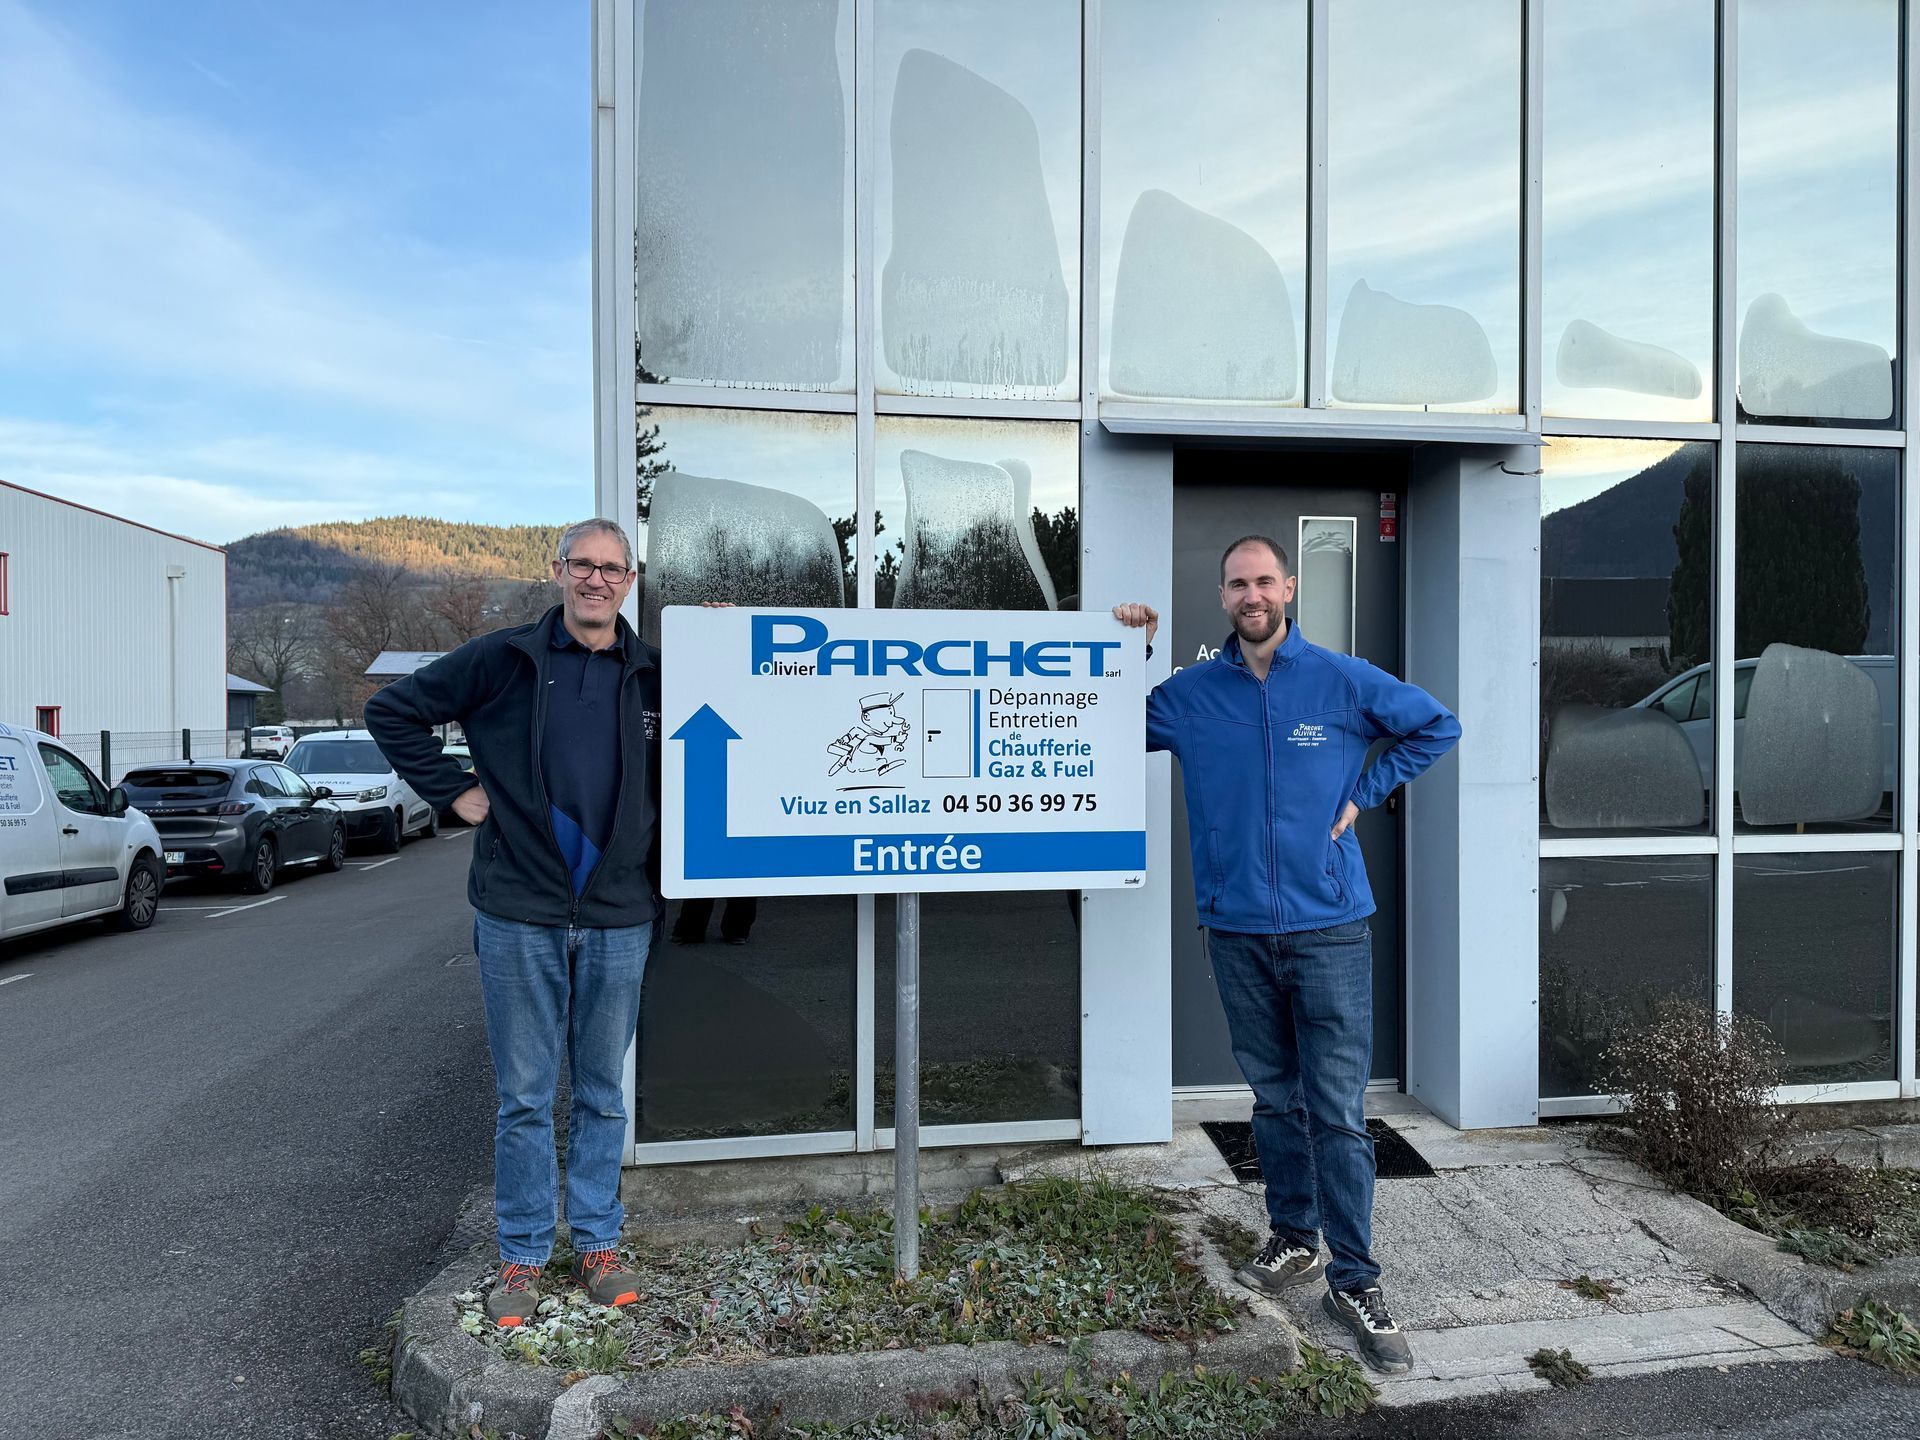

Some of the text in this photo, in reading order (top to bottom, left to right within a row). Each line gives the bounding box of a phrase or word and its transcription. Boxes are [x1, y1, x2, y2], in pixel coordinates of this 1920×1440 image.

[751, 615, 1121, 677] PARCHET
[759, 660, 816, 676] Olivier
[1105, 668, 1121, 678] sarl
[989, 687, 1098, 709] Dépannage
[989, 711, 1078, 728] Entretien
[1009, 731, 1022, 741] de
[988, 739, 1092, 756] Chaufferie
[988, 759, 1094, 778] Gaz & Fuel
[780, 793, 1097, 815] Viuz en Sallaz 04 50 36 99 75
[853, 835, 982, 872] Entrée
